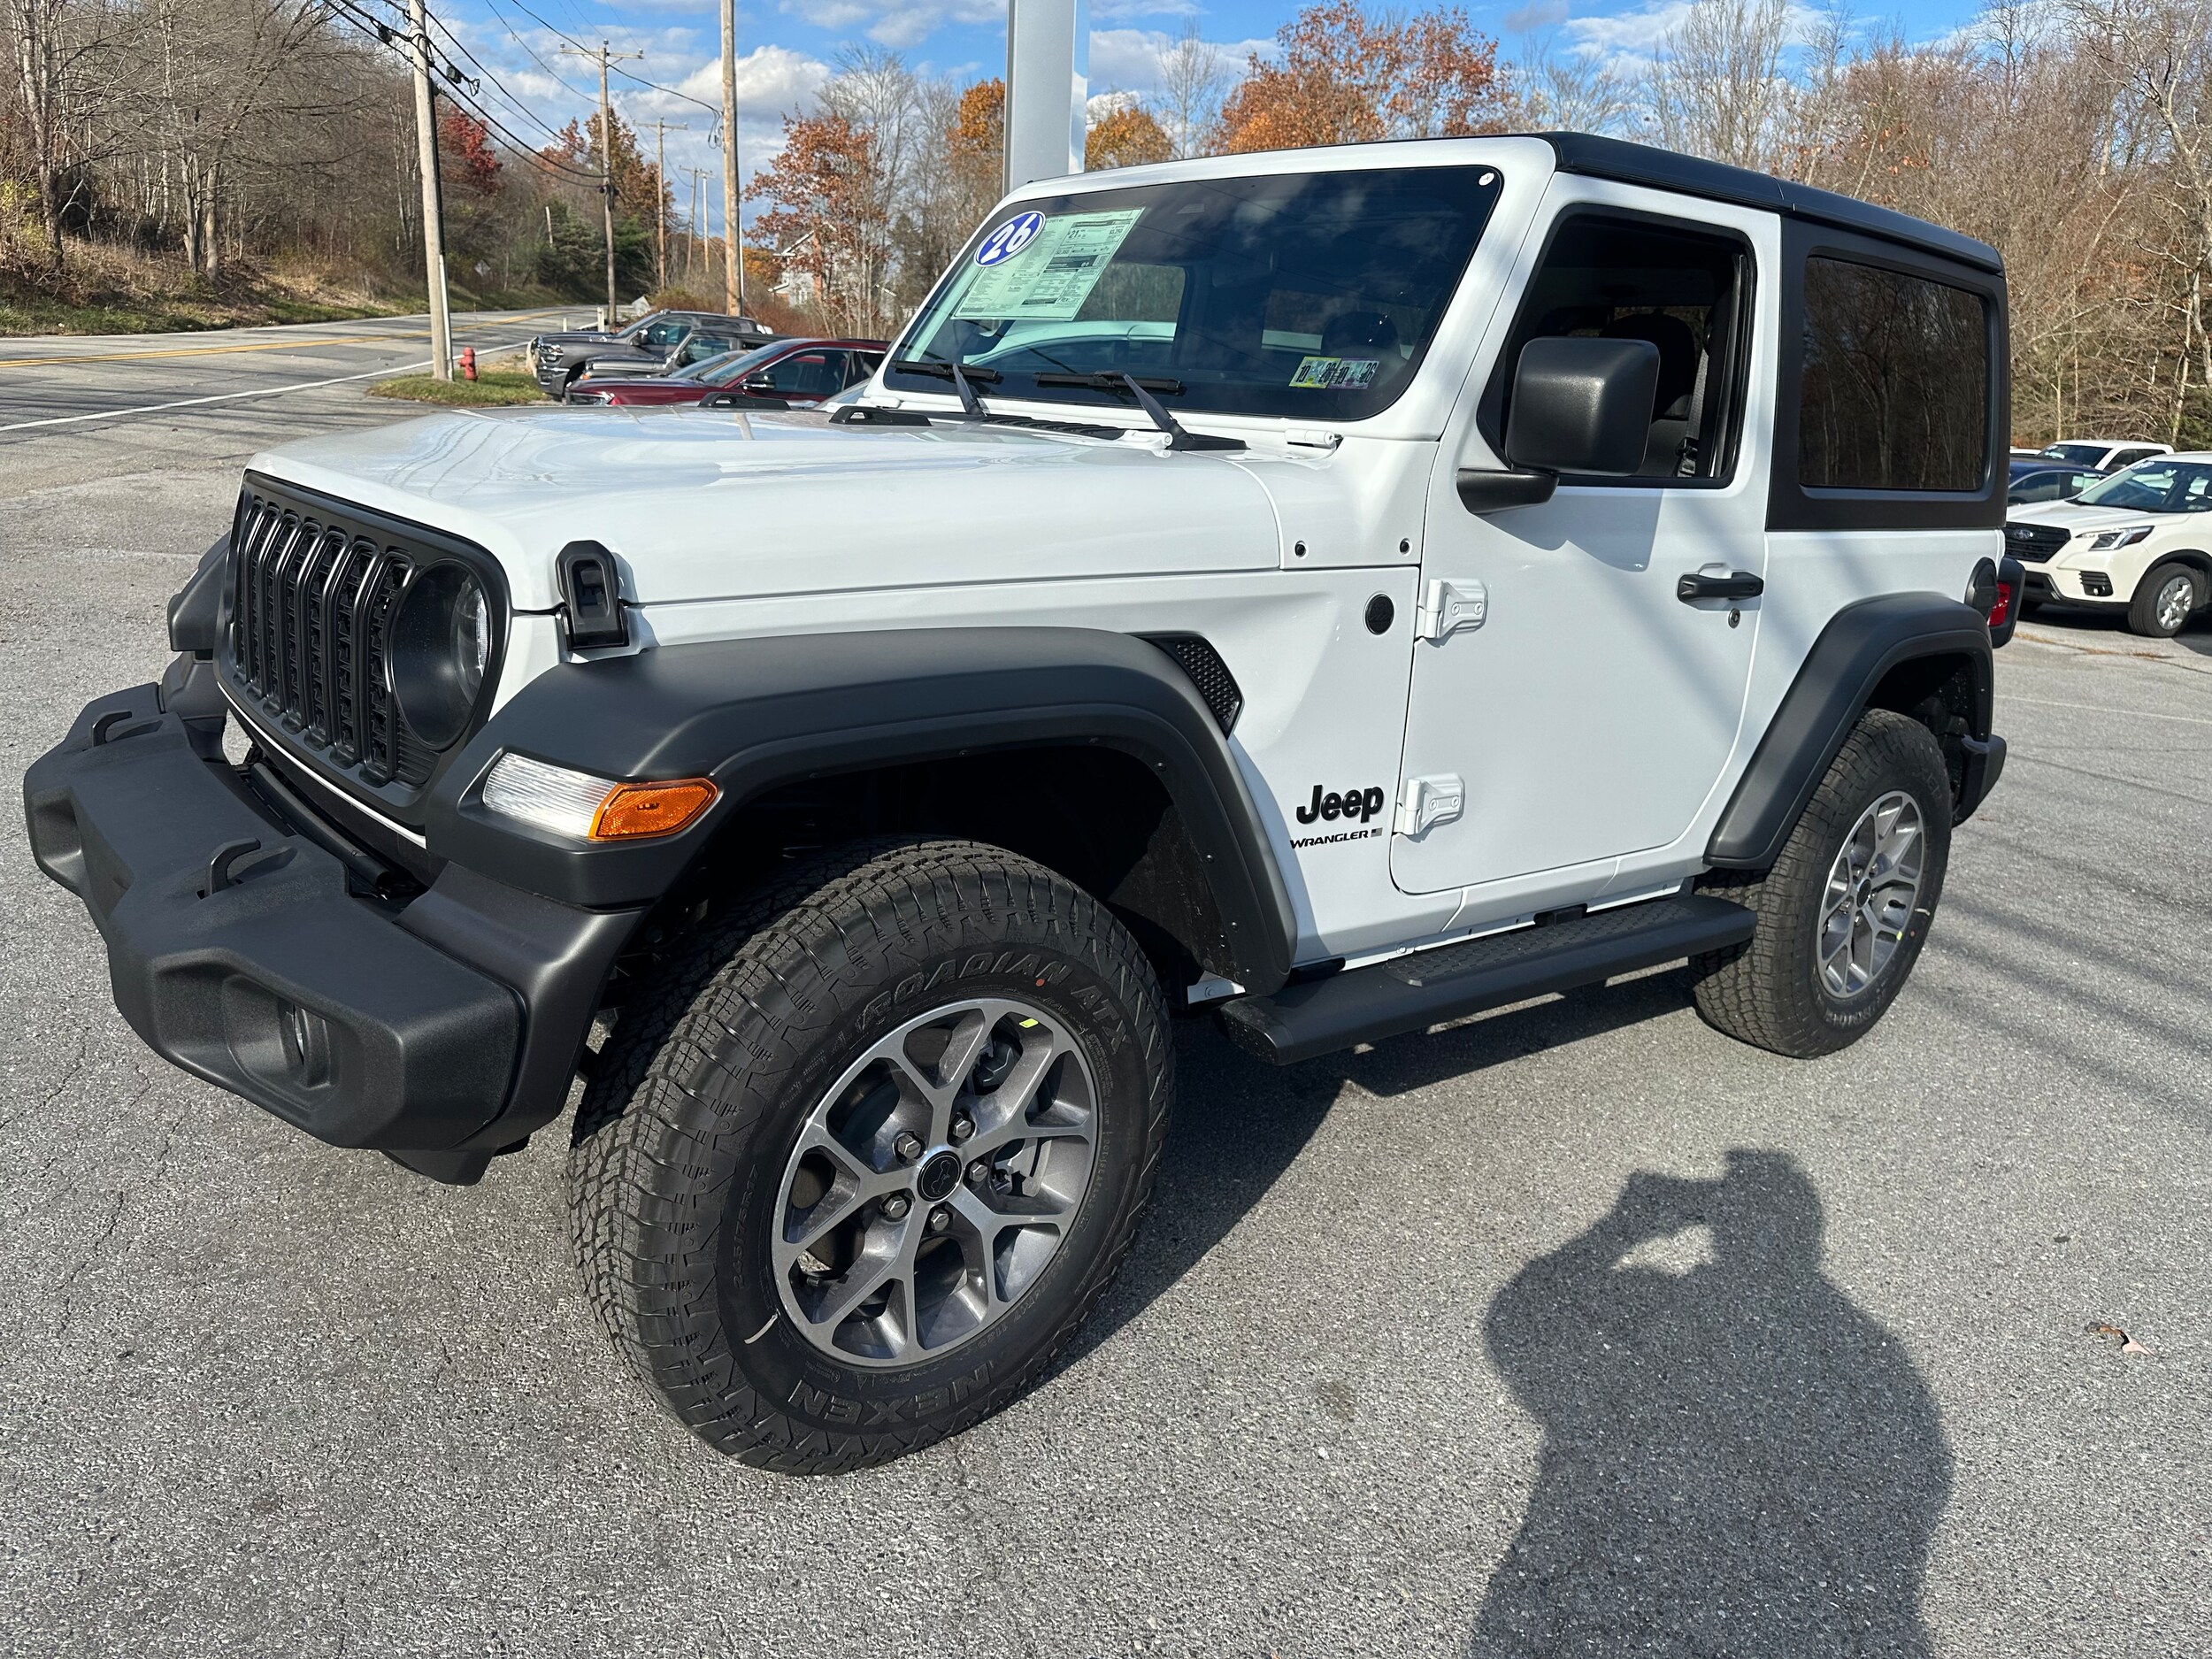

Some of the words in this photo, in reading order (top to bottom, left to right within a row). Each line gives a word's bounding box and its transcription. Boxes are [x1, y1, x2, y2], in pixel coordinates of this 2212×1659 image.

[980, 213, 1038, 265] 26
[1296, 365, 1311, 382] 10
[1296, 784, 1384, 824] Jeep
[1290, 830, 1368, 849] WRANGLER
[1071, 985, 1133, 1055] ATX
[787, 1361, 992, 1426] NEXEN
